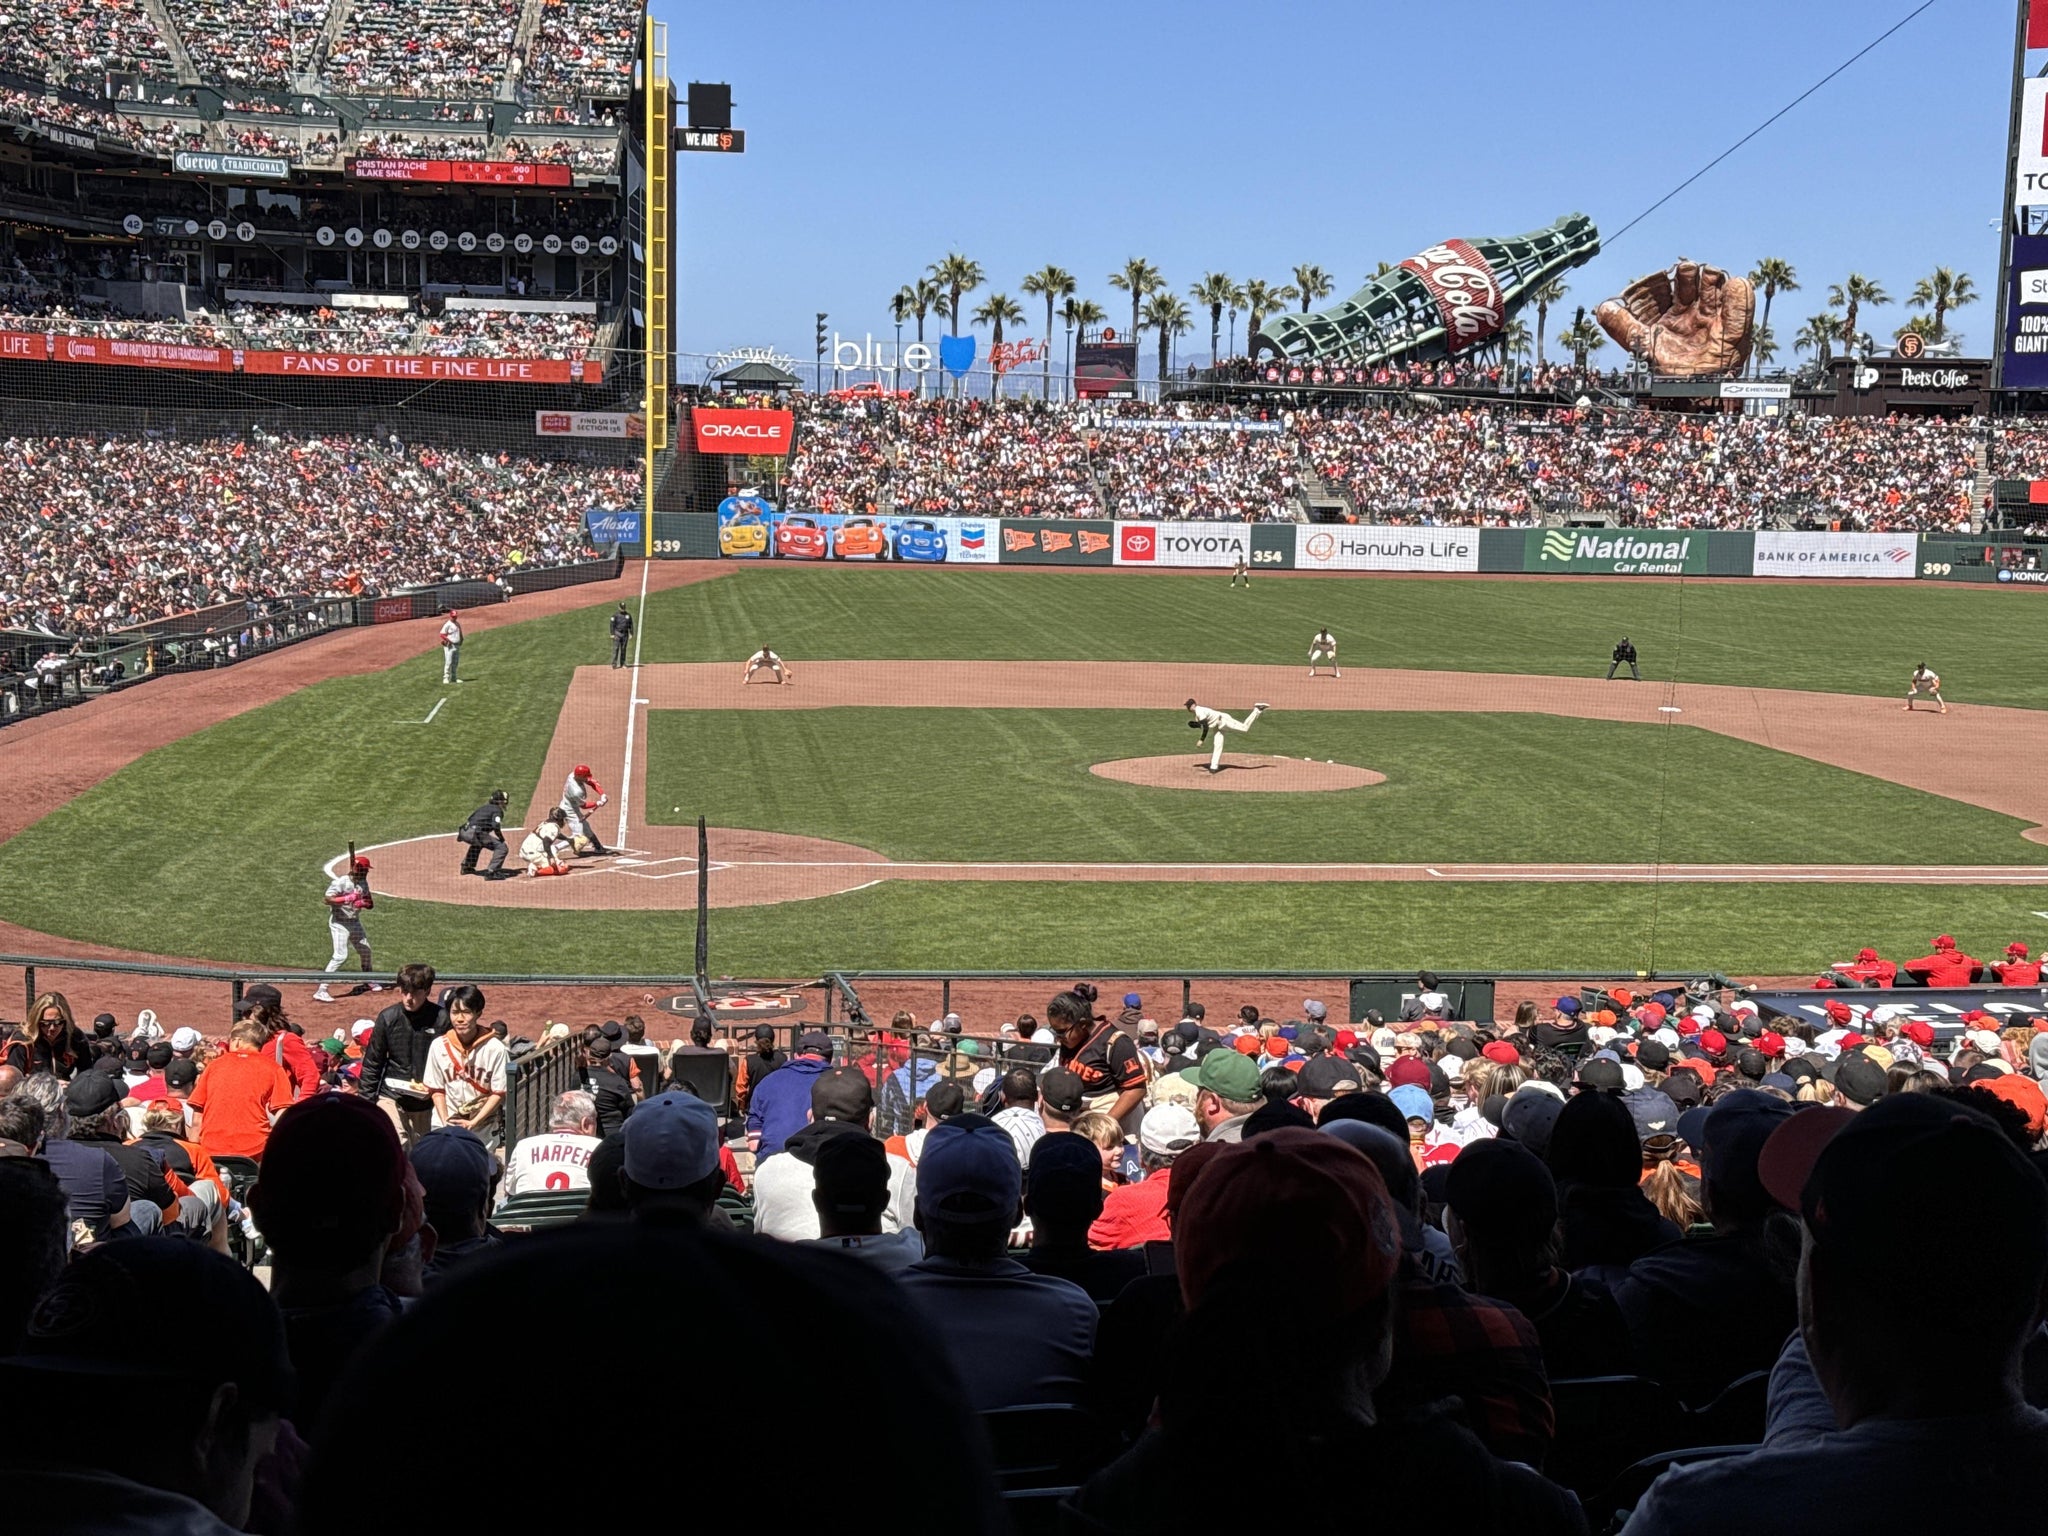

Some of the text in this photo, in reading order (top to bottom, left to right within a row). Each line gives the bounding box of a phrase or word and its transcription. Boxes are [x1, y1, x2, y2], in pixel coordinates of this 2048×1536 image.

[685, 132, 700, 146] WE
[701, 133, 719, 147] ARE
[227, 160, 281, 173] TRADICIONAL
[356, 160, 428, 171] CRISTIAN PACHE
[356, 169, 412, 179] BLAKE SNELL
[126, 220, 140, 229] 42
[322, 231, 329, 241] 3
[350, 233, 357, 241] 4
[378, 234, 387, 243] 11
[404, 235, 417, 244] 20
[432, 236, 445, 245] 22
[461, 237, 474, 246] 24
[489, 238, 502, 247] 25
[517, 239, 530, 248] 27
[546, 240, 559, 248] 30
[601, 241, 615, 250] 44
[4, 336, 31, 354] LIFE
[68, 340, 96, 359] Corona
[833, 332, 932, 372] blue
[283, 356, 533, 378] FANS OF THE FINE LIFE
[1901, 367, 1969, 389] Peet's Coffee
[1745, 386, 1790, 394] CHEVROLET
[701, 424, 781, 438] ORACLE
[591, 516, 637, 531] Alaska
[653, 540, 681, 552] 339
[1163, 537, 1244, 552] TOYOTA
[1340, 540, 1468, 557] Hanwha Life
[1253, 550, 1282, 562] 354
[1758, 552, 1880, 562] BANK OF AMERICA
[1613, 562, 1683, 573] Car Rental
[1923, 562, 1952, 575] 399
[379, 602, 407, 617] ORACLE
[531, 1145, 591, 1169] HARPER
